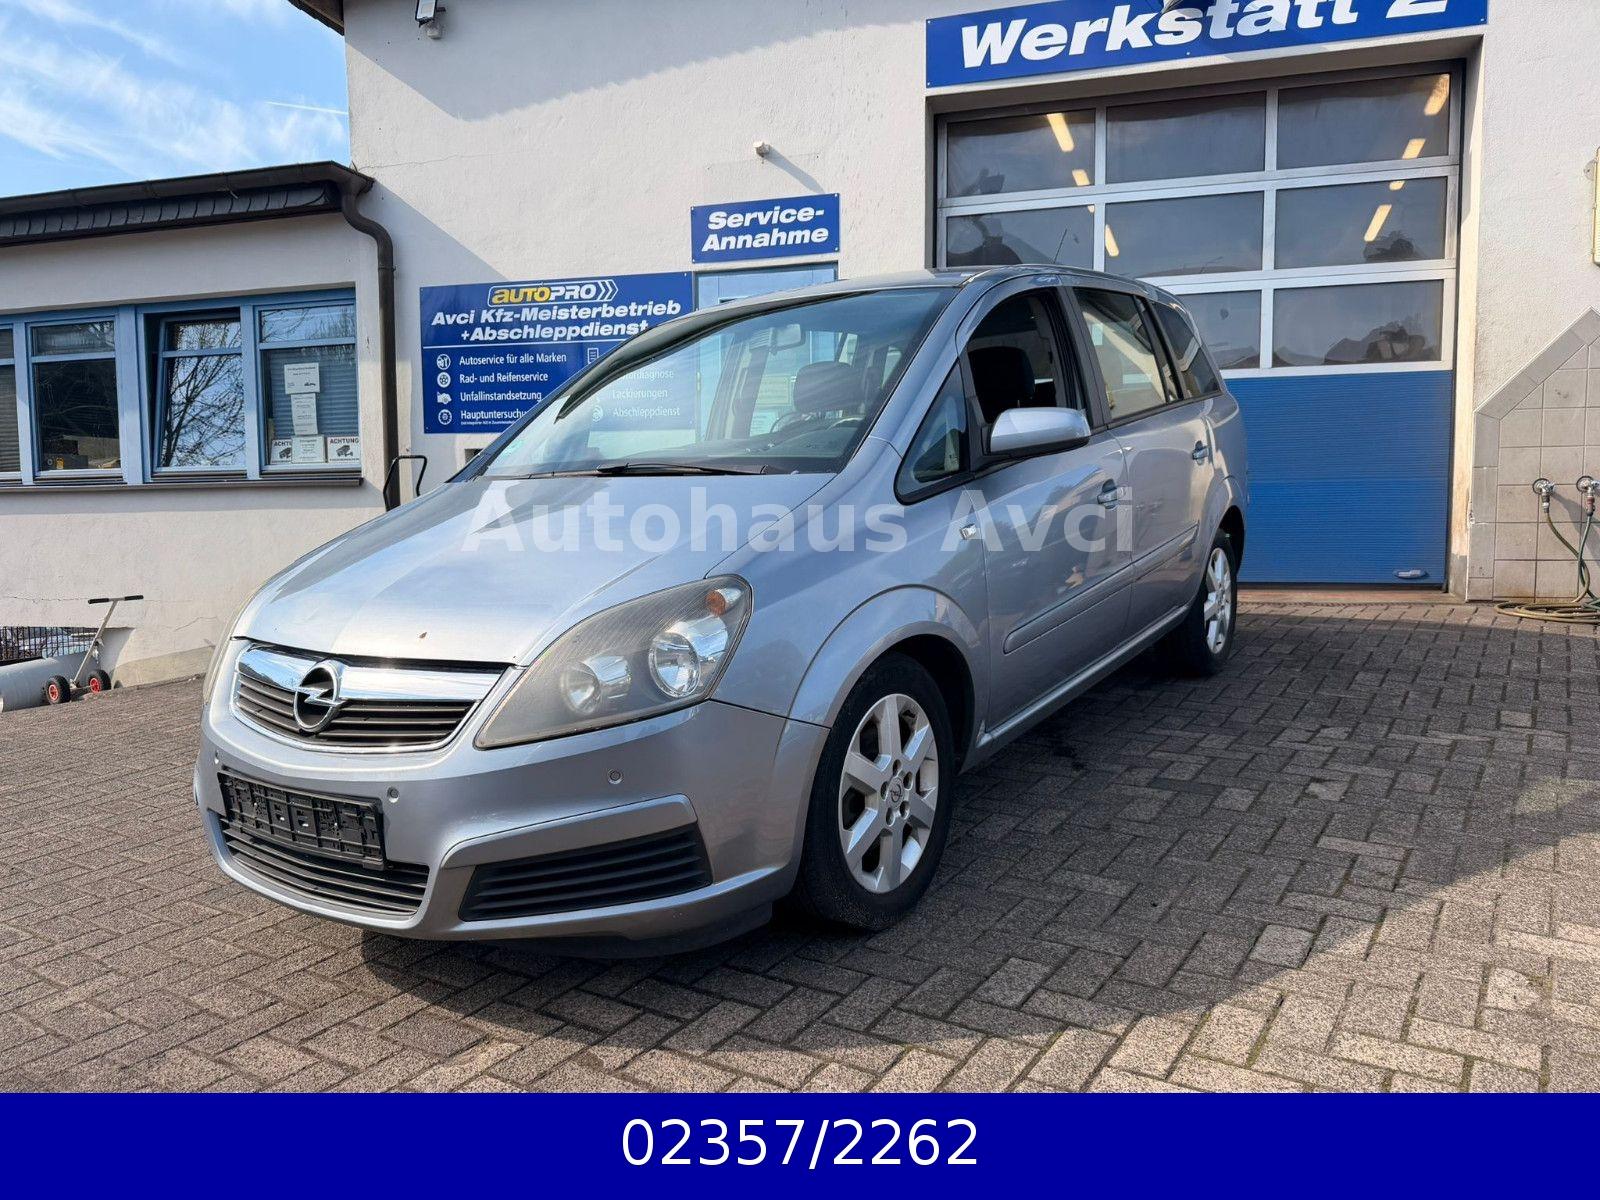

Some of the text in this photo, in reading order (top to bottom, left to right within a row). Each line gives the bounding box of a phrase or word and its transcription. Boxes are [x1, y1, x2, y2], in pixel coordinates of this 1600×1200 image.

[960, 0, 1359, 69] Werkstatt
[707, 205, 825, 230] Service-
[701, 227, 829, 252] Annahme
[431, 299, 682, 326] Avci Kfz-Meisterbetrieb
[461, 319, 649, 341] +Abschleppdienst
[459, 352, 567, 366] Autoservice für alle Marken
[460, 371, 549, 384] Rad- und Reifenservice
[460, 390, 542, 403] Unfallinstandsetzung
[613, 405, 681, 419] Abschleppdienst
